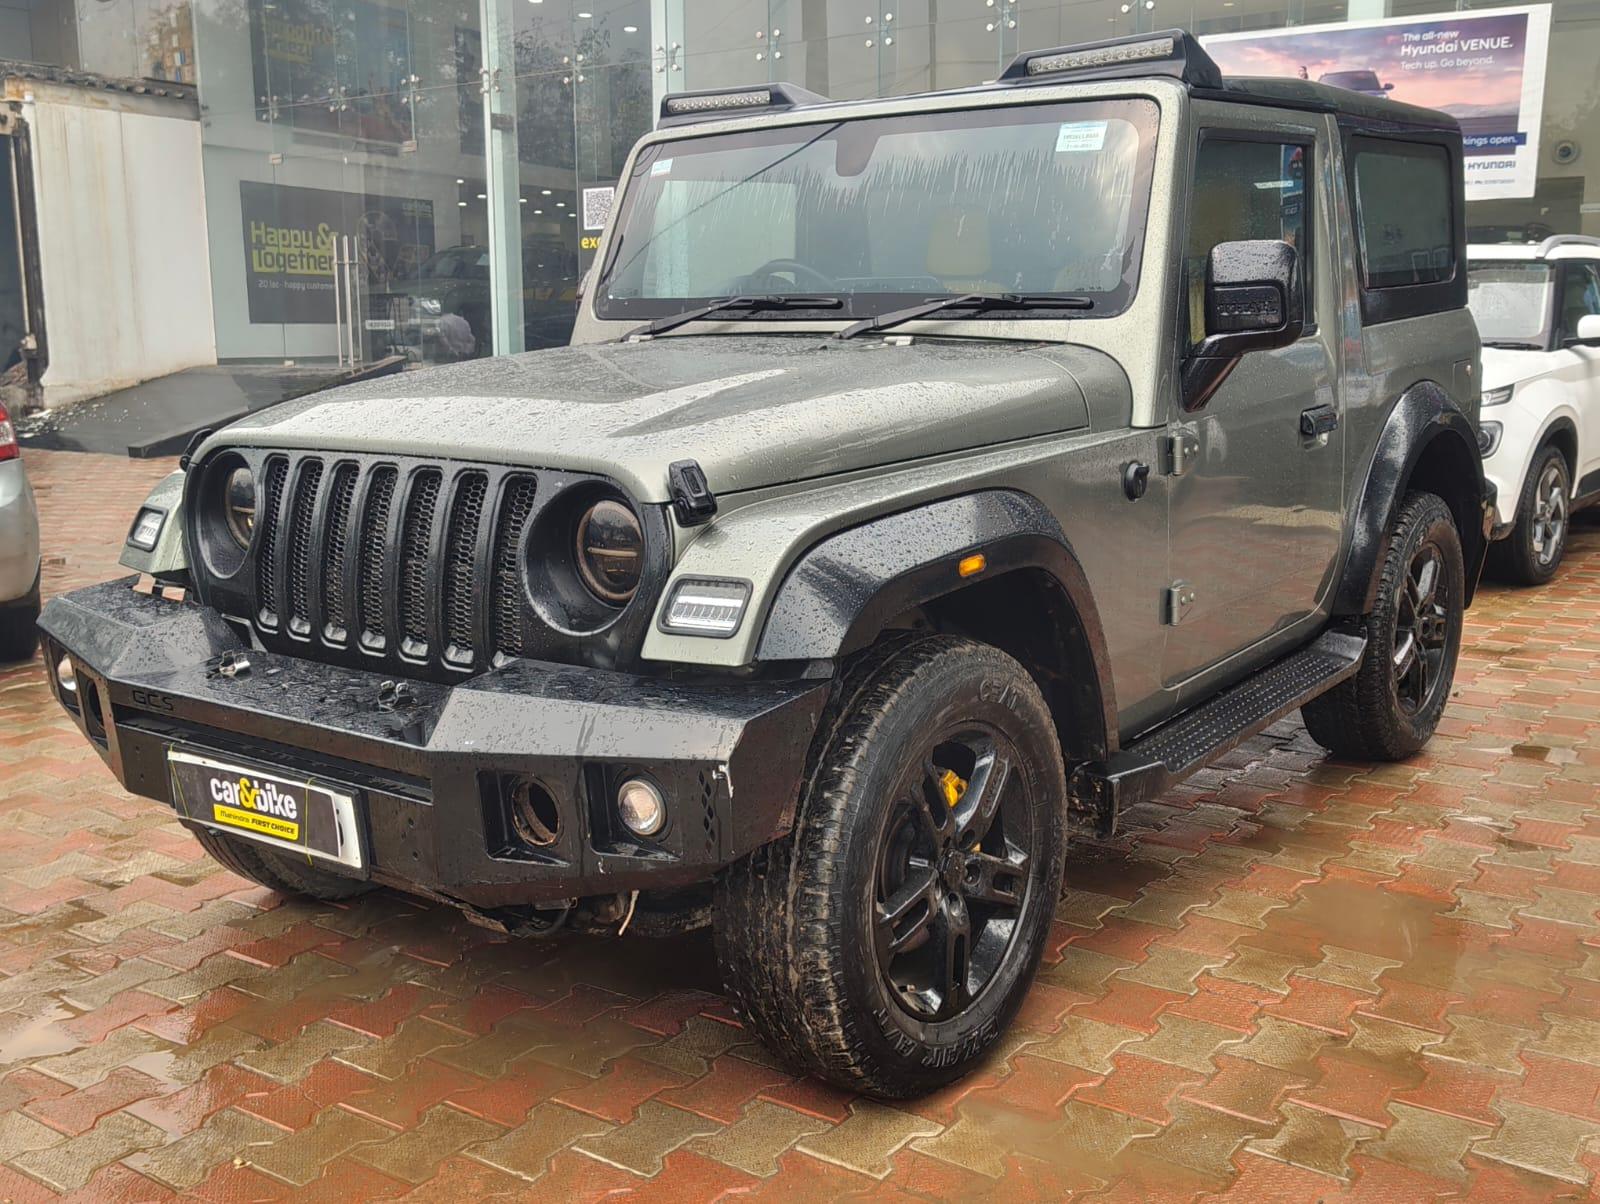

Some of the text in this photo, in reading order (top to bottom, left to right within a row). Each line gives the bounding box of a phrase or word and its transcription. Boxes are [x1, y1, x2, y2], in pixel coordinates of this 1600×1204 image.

[1401, 36, 1513, 57] Hyundai VENUE.
[1403, 31, 1459, 42] The all-new
[1401, 61, 1422, 70] Tech
[1439, 58, 1455, 68] Go
[1456, 56, 1495, 67] beyond.
[1463, 135, 1517, 147] kings open.
[1467, 160, 1517, 170] HYUNDAI
[251, 221, 313, 249] Happy
[254, 245, 334, 273] Together
[258, 279, 269, 288] 20
[284, 279, 307, 291] happy
[132, 690, 175, 711] GCS
[210, 777, 298, 820] car&bike
[220, 810, 295, 834] Mahindra FIRST CHOICE
